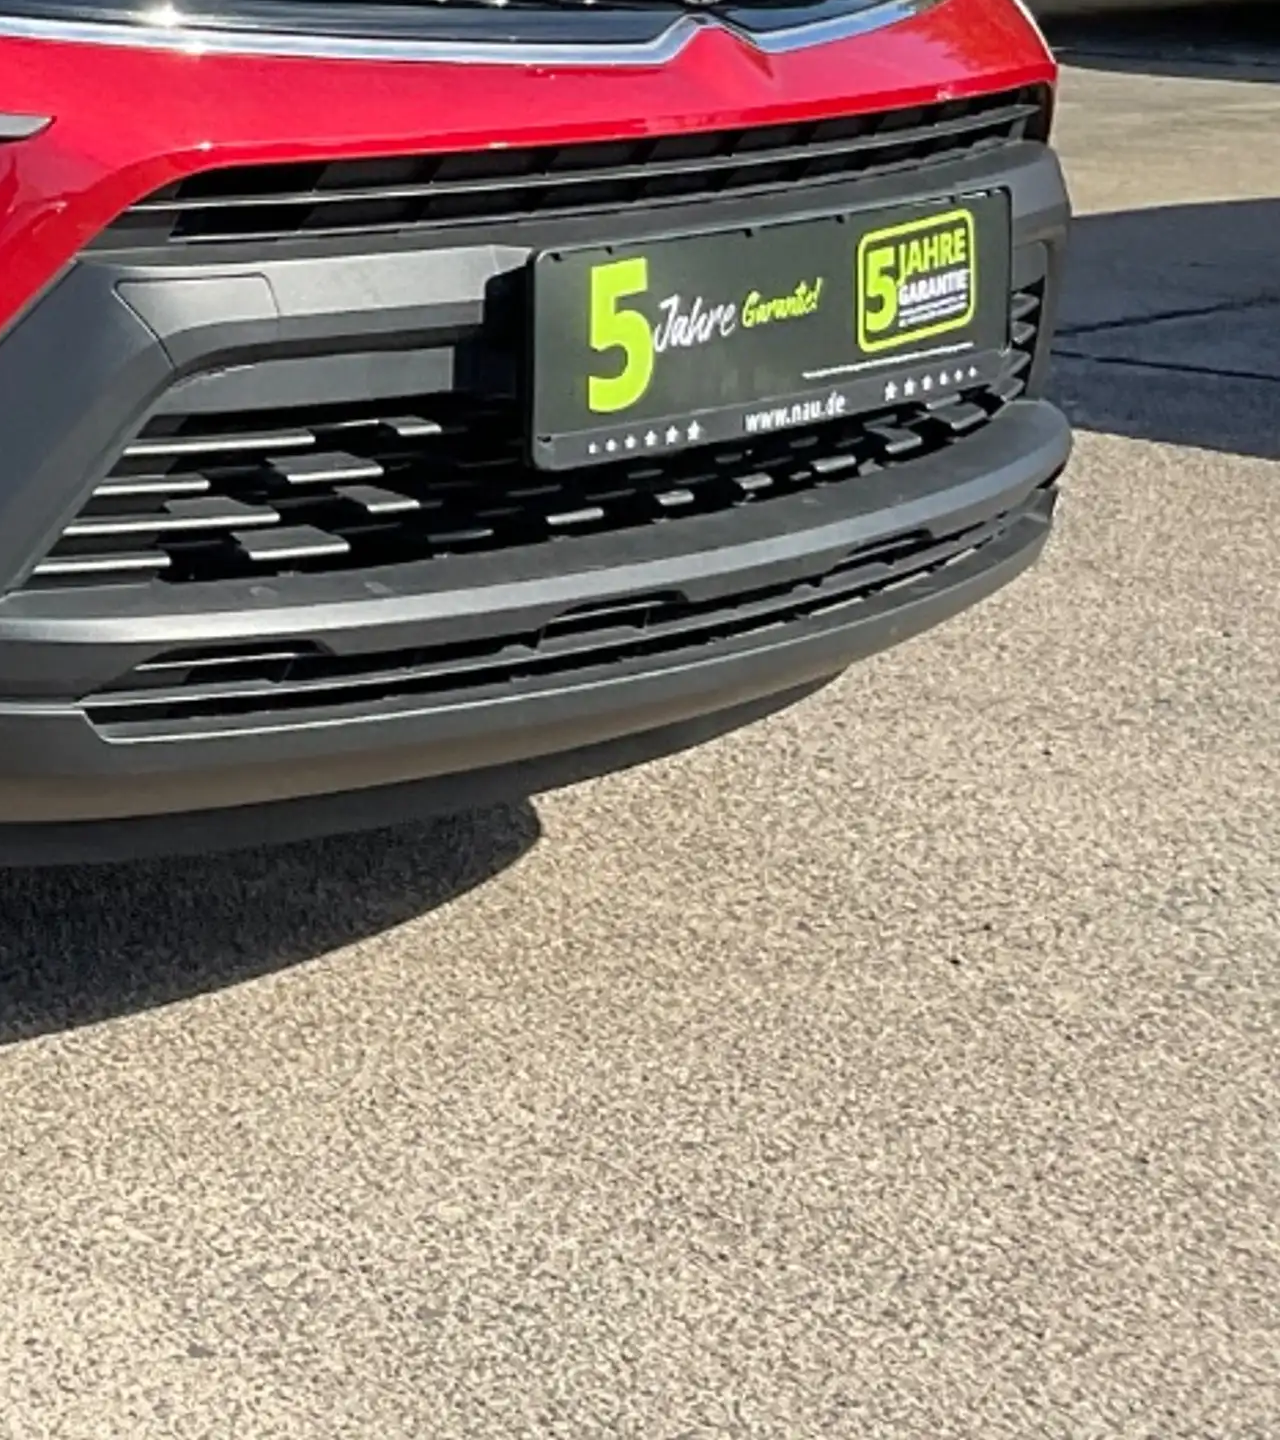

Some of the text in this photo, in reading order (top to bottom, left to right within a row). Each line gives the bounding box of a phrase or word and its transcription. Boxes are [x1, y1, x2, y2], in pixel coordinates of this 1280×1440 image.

[866, 246, 897, 331] 5
[897, 227, 967, 286] JAHRE
[898, 267, 970, 306] GARANTIE
[589, 256, 824, 412] 5 Jahre Garantie!
[744, 389, 846, 432] www.nau.de
